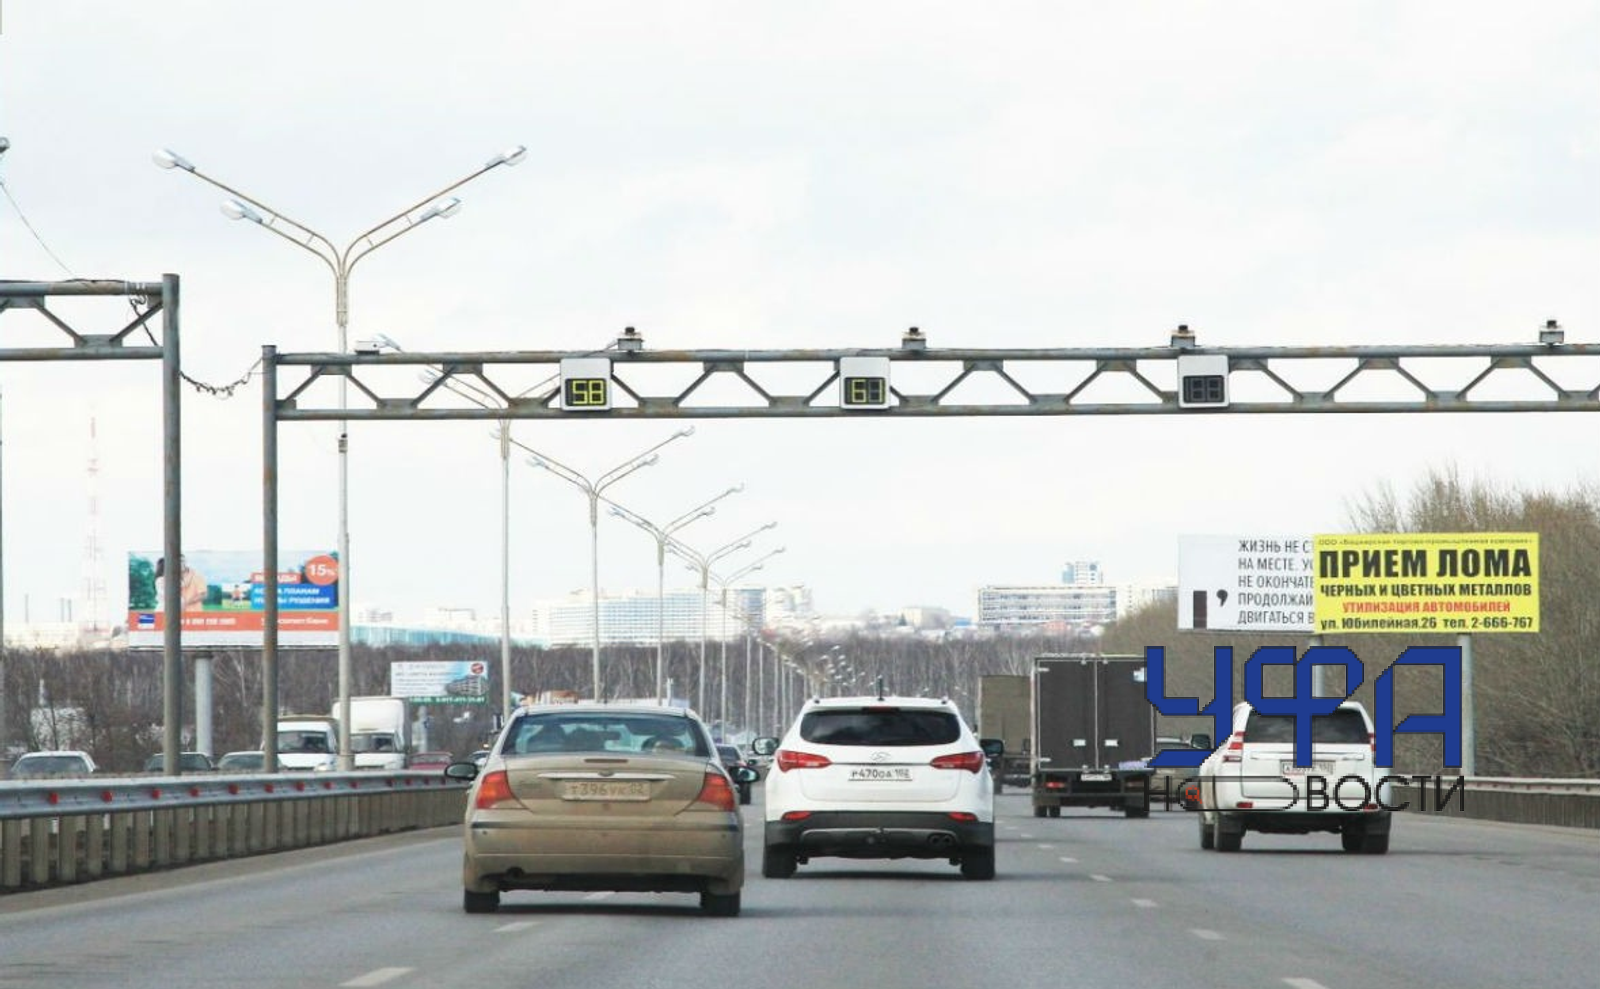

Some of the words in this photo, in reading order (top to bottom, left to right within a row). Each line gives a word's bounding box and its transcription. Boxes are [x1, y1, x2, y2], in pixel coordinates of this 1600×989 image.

[572, 380, 604, 404] 58
[1238, 539, 1281, 553] ЖИЗНЬ
[1285, 539, 1300, 553] НЕ
[1238, 557, 1254, 571] НА
[1319, 549, 1427, 578] ПРИЕМ
[1436, 548, 1533, 577] ЛОМА
[1238, 575, 1254, 588] НЕ
[1320, 583, 1376, 597] ЧЕРНЫХ
[1380, 583, 1388, 596] И
[1390, 583, 1456, 598] ЦВЕТНЫХ
[1458, 583, 1532, 596] МЕТАЛЛОВ
[1342, 601, 1420, 614] УТИЛИЗАЦИЯ
[1422, 600, 1511, 613] АВТОМОБИЛЕЙ
[1237, 610, 1304, 625] ДВИГАТЬСЯ
[1320, 619, 1340, 631] ул.
[1443, 618, 1469, 629] тел.
[1471, 616, 1533, 629] 2-666-767
